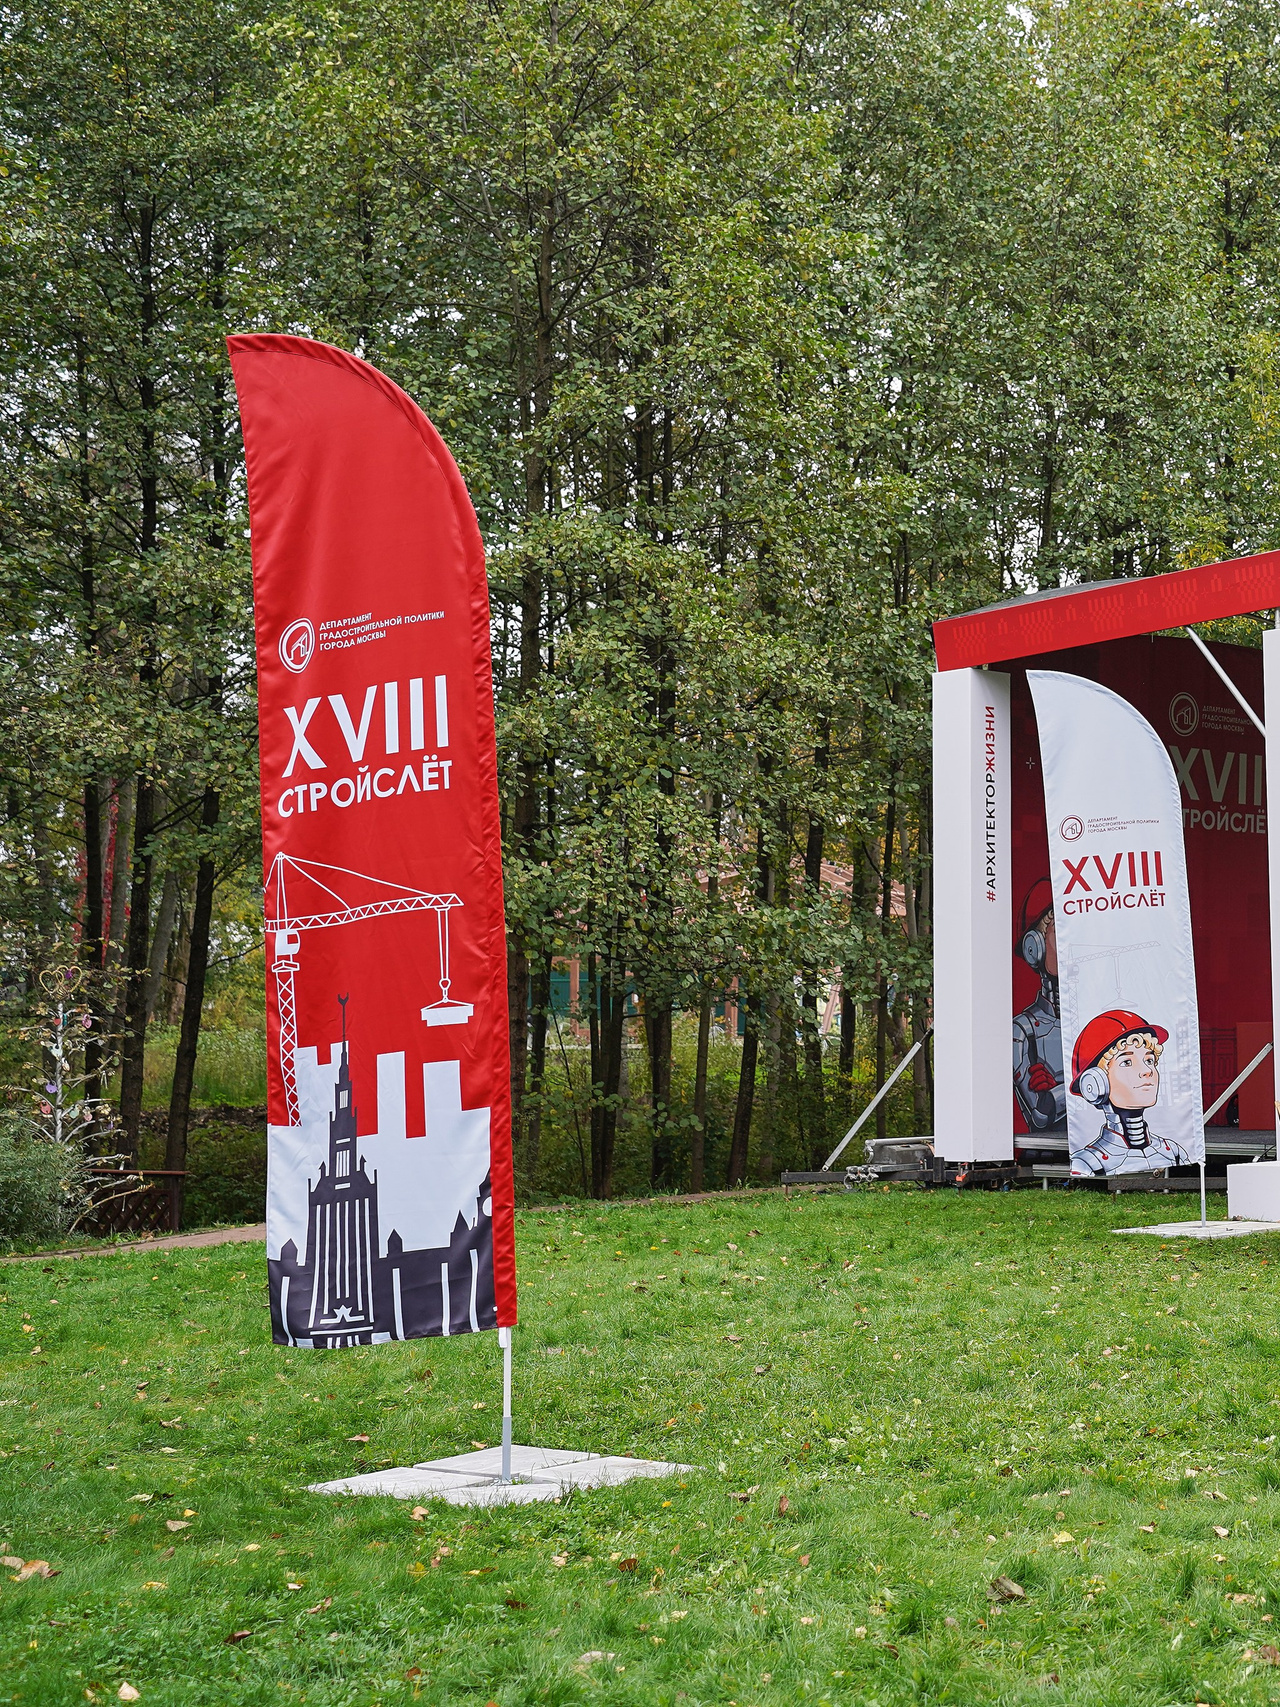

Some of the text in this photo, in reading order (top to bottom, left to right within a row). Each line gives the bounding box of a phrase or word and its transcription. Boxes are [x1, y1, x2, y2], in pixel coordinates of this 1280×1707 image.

[319, 612, 372, 631] ДЕПАРТАМЕНТ
[319, 611, 445, 640] ГРАДОСТРОИТЕЛЬНОЙ ПОЛИТИКИ
[319, 630, 386, 651] ГОРОДА МОСКВЫ
[281, 674, 449, 778] XVIII
[277, 754, 453, 818] СТРОЙСЛЁТ
[1169, 745, 1263, 806] XVII
[985, 705, 996, 902] #АРХИТЕКТОРЖИЗНИ
[1182, 805, 1266, 834] ТРОЙСЛЁ
[1062, 851, 1163, 895] XVIII
[1063, 889, 1166, 915] СТРОЙСЛЁТ
